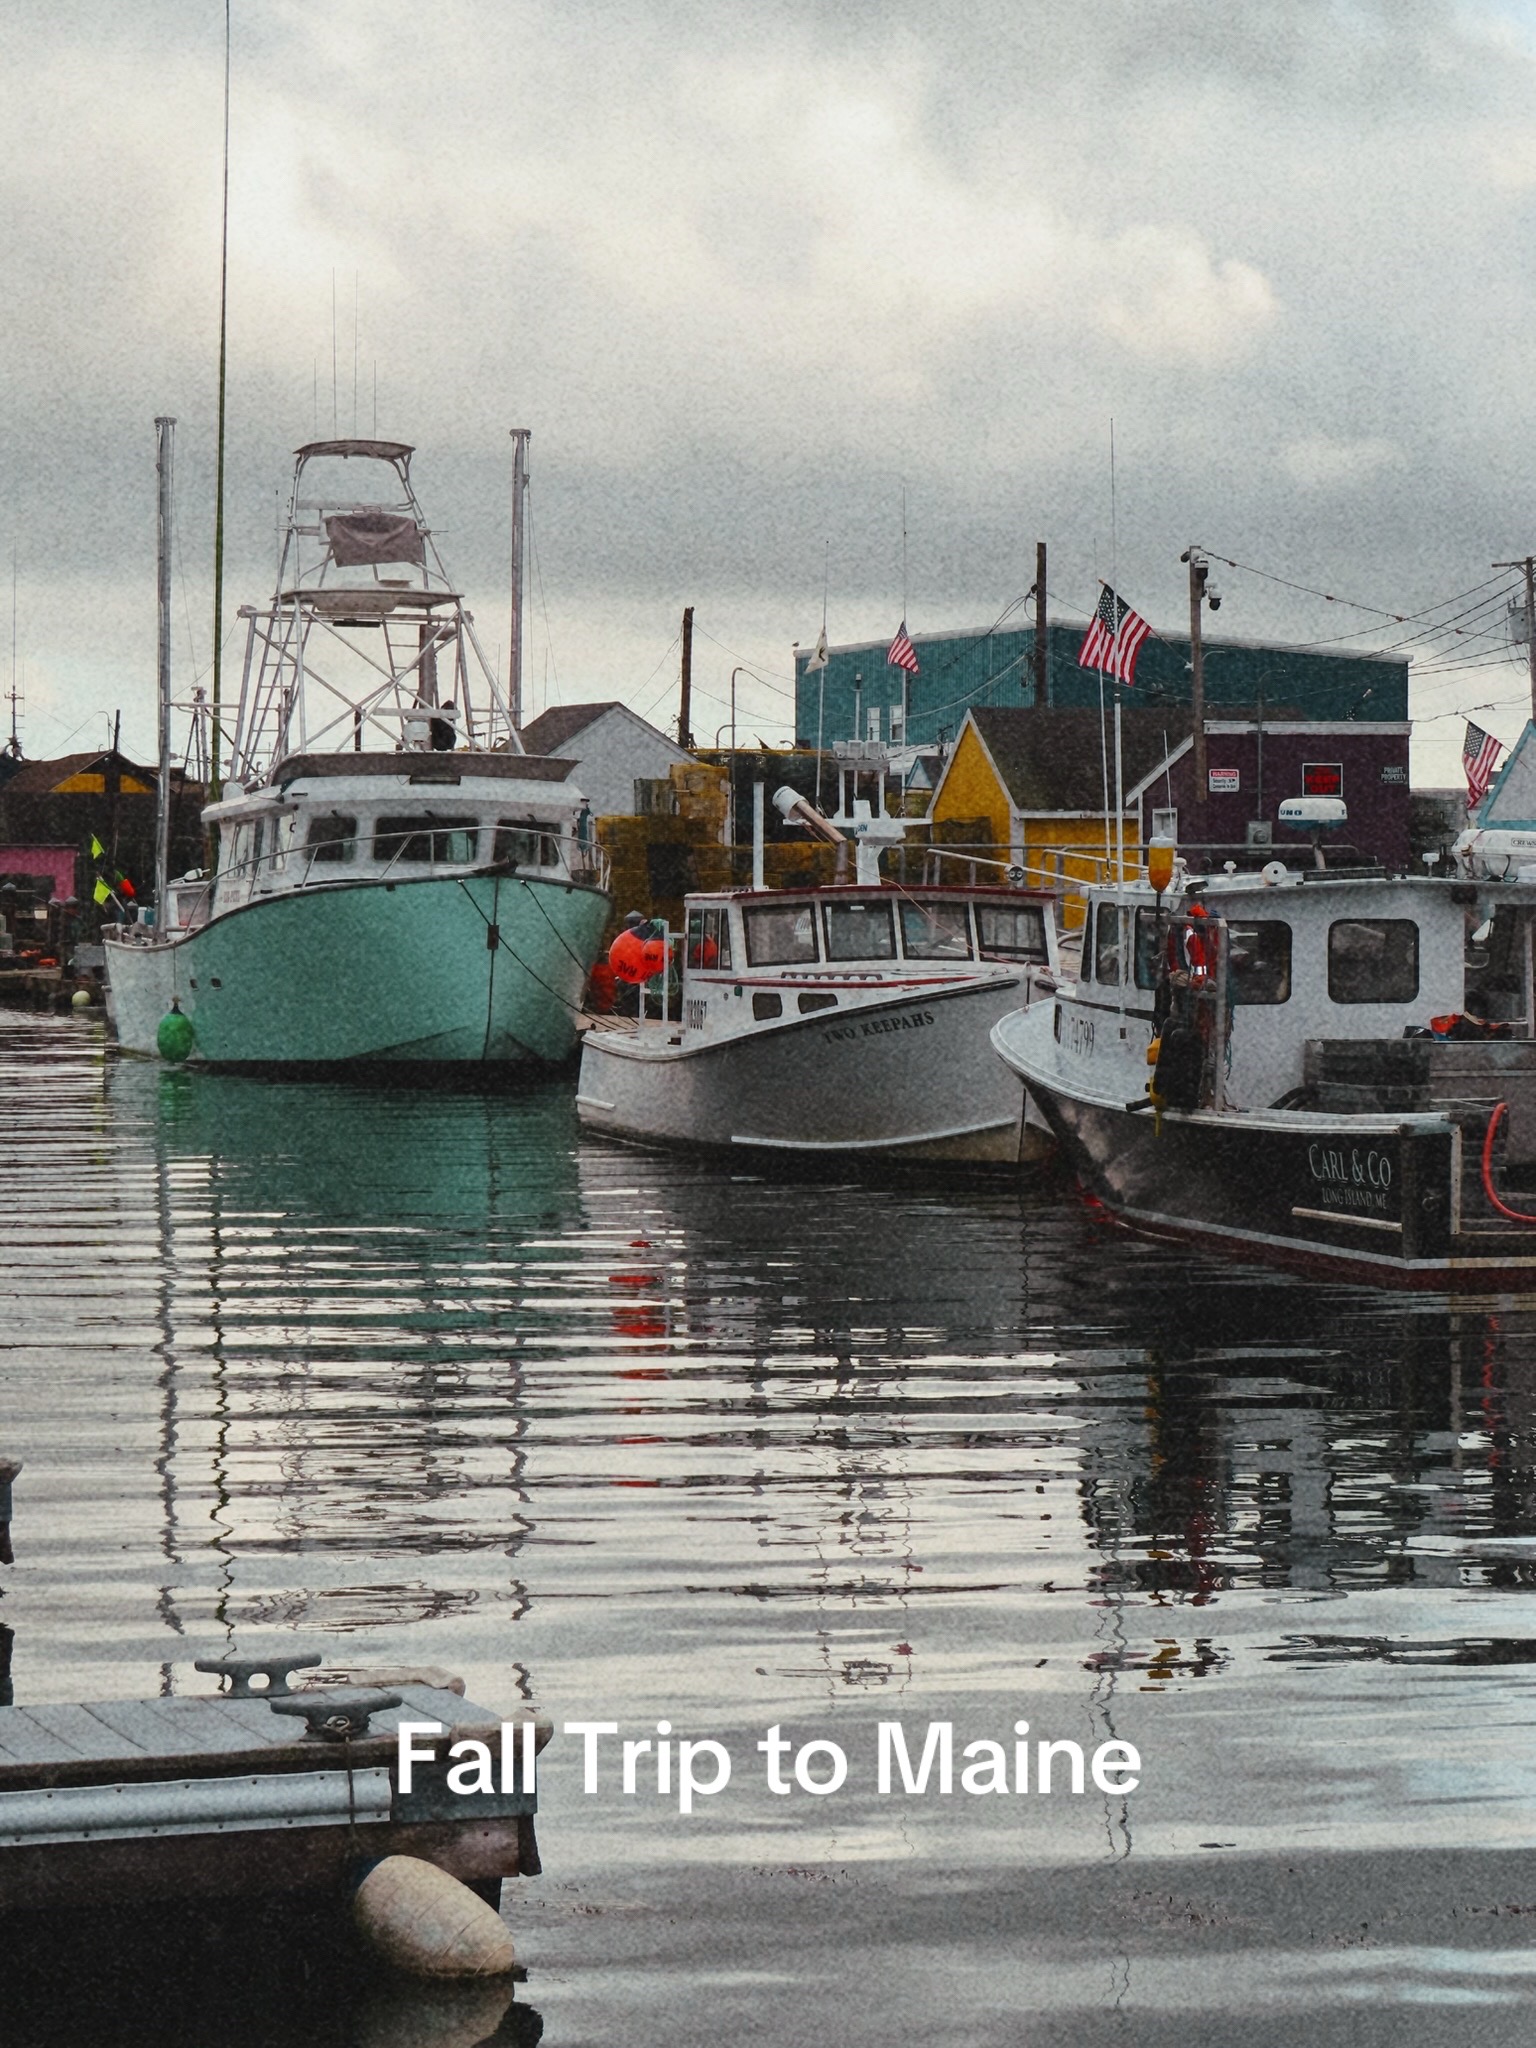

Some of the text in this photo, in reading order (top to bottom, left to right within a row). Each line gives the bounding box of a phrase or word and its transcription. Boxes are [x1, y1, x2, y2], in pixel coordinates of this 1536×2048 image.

[822, 1011, 935, 1044] TWO KEEPAHS
[1309, 1144, 1348, 1181] CARL
[1352, 1149, 1366, 1185] &
[1321, 1187, 1344, 1205] LONG
